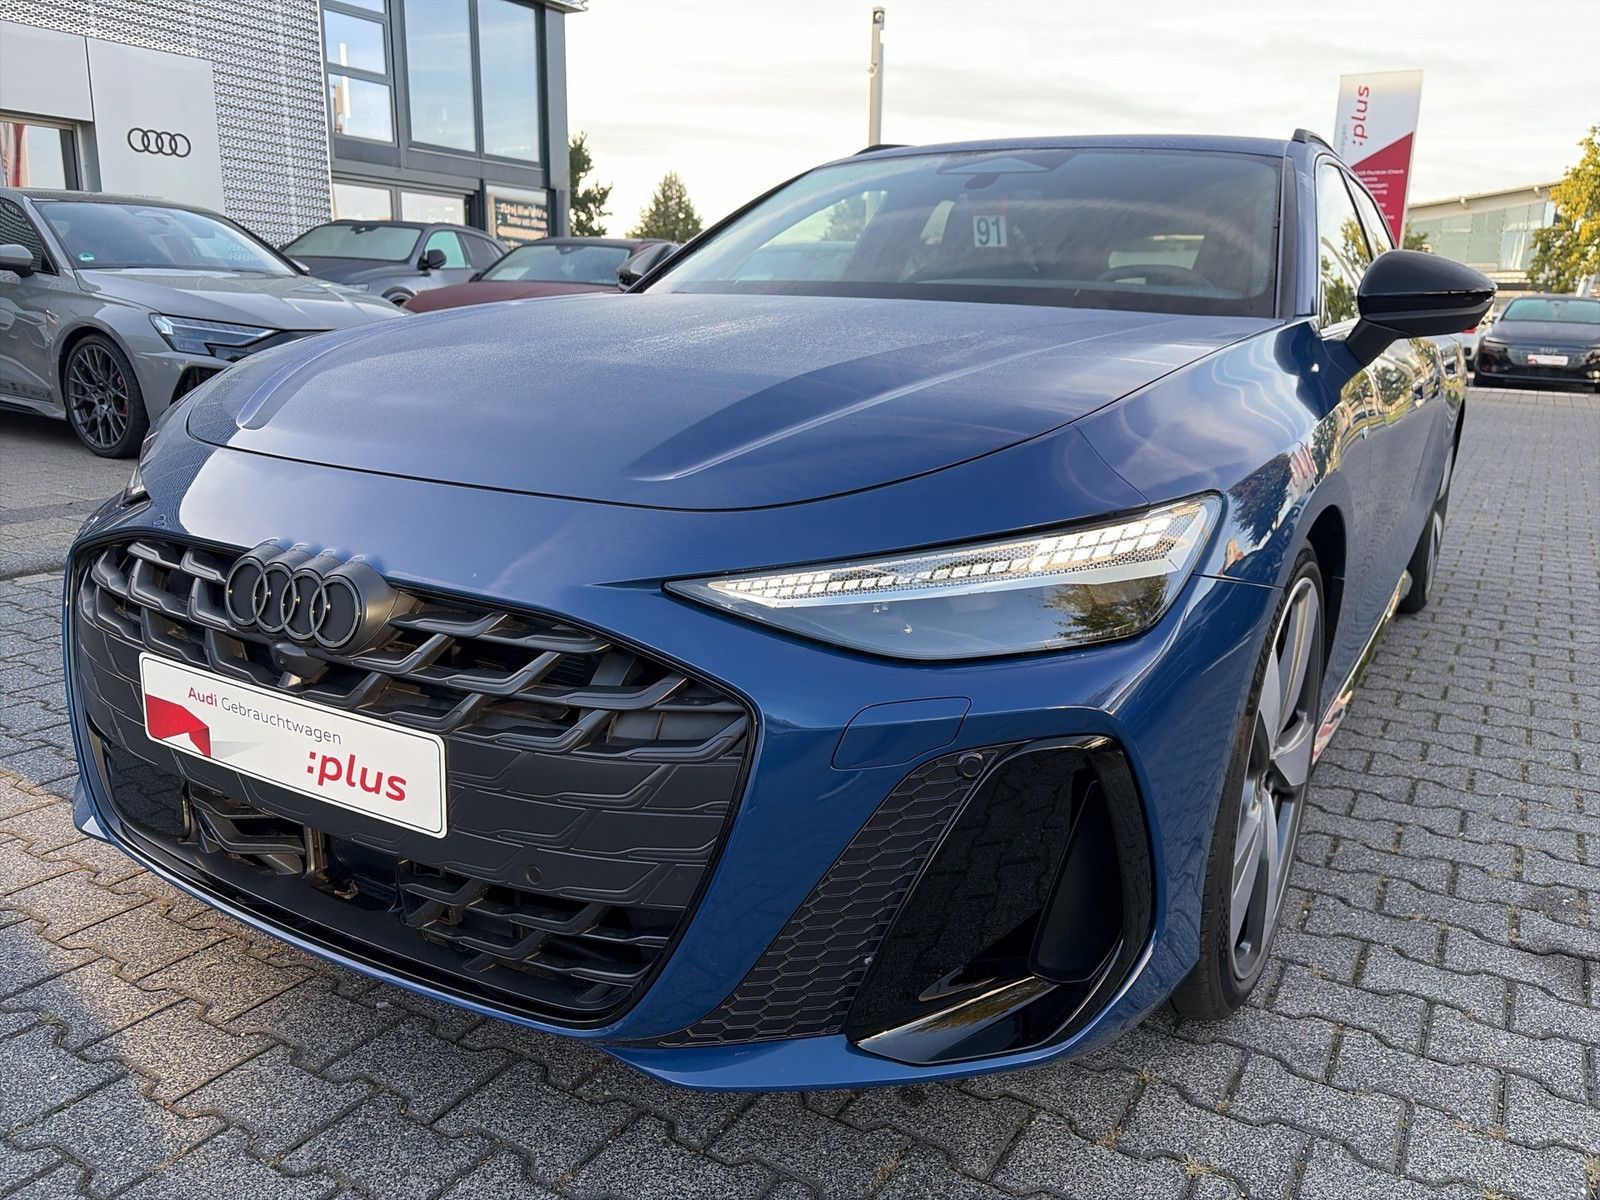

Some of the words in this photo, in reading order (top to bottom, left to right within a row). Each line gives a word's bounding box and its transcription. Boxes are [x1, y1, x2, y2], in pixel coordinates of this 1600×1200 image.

[1351, 85, 1370, 146] :plus
[976, 216, 1002, 246] 91
[188, 686, 218, 708] Audi
[221, 697, 342, 745] Gebrauchtwagen
[306, 750, 408, 802] :plus
